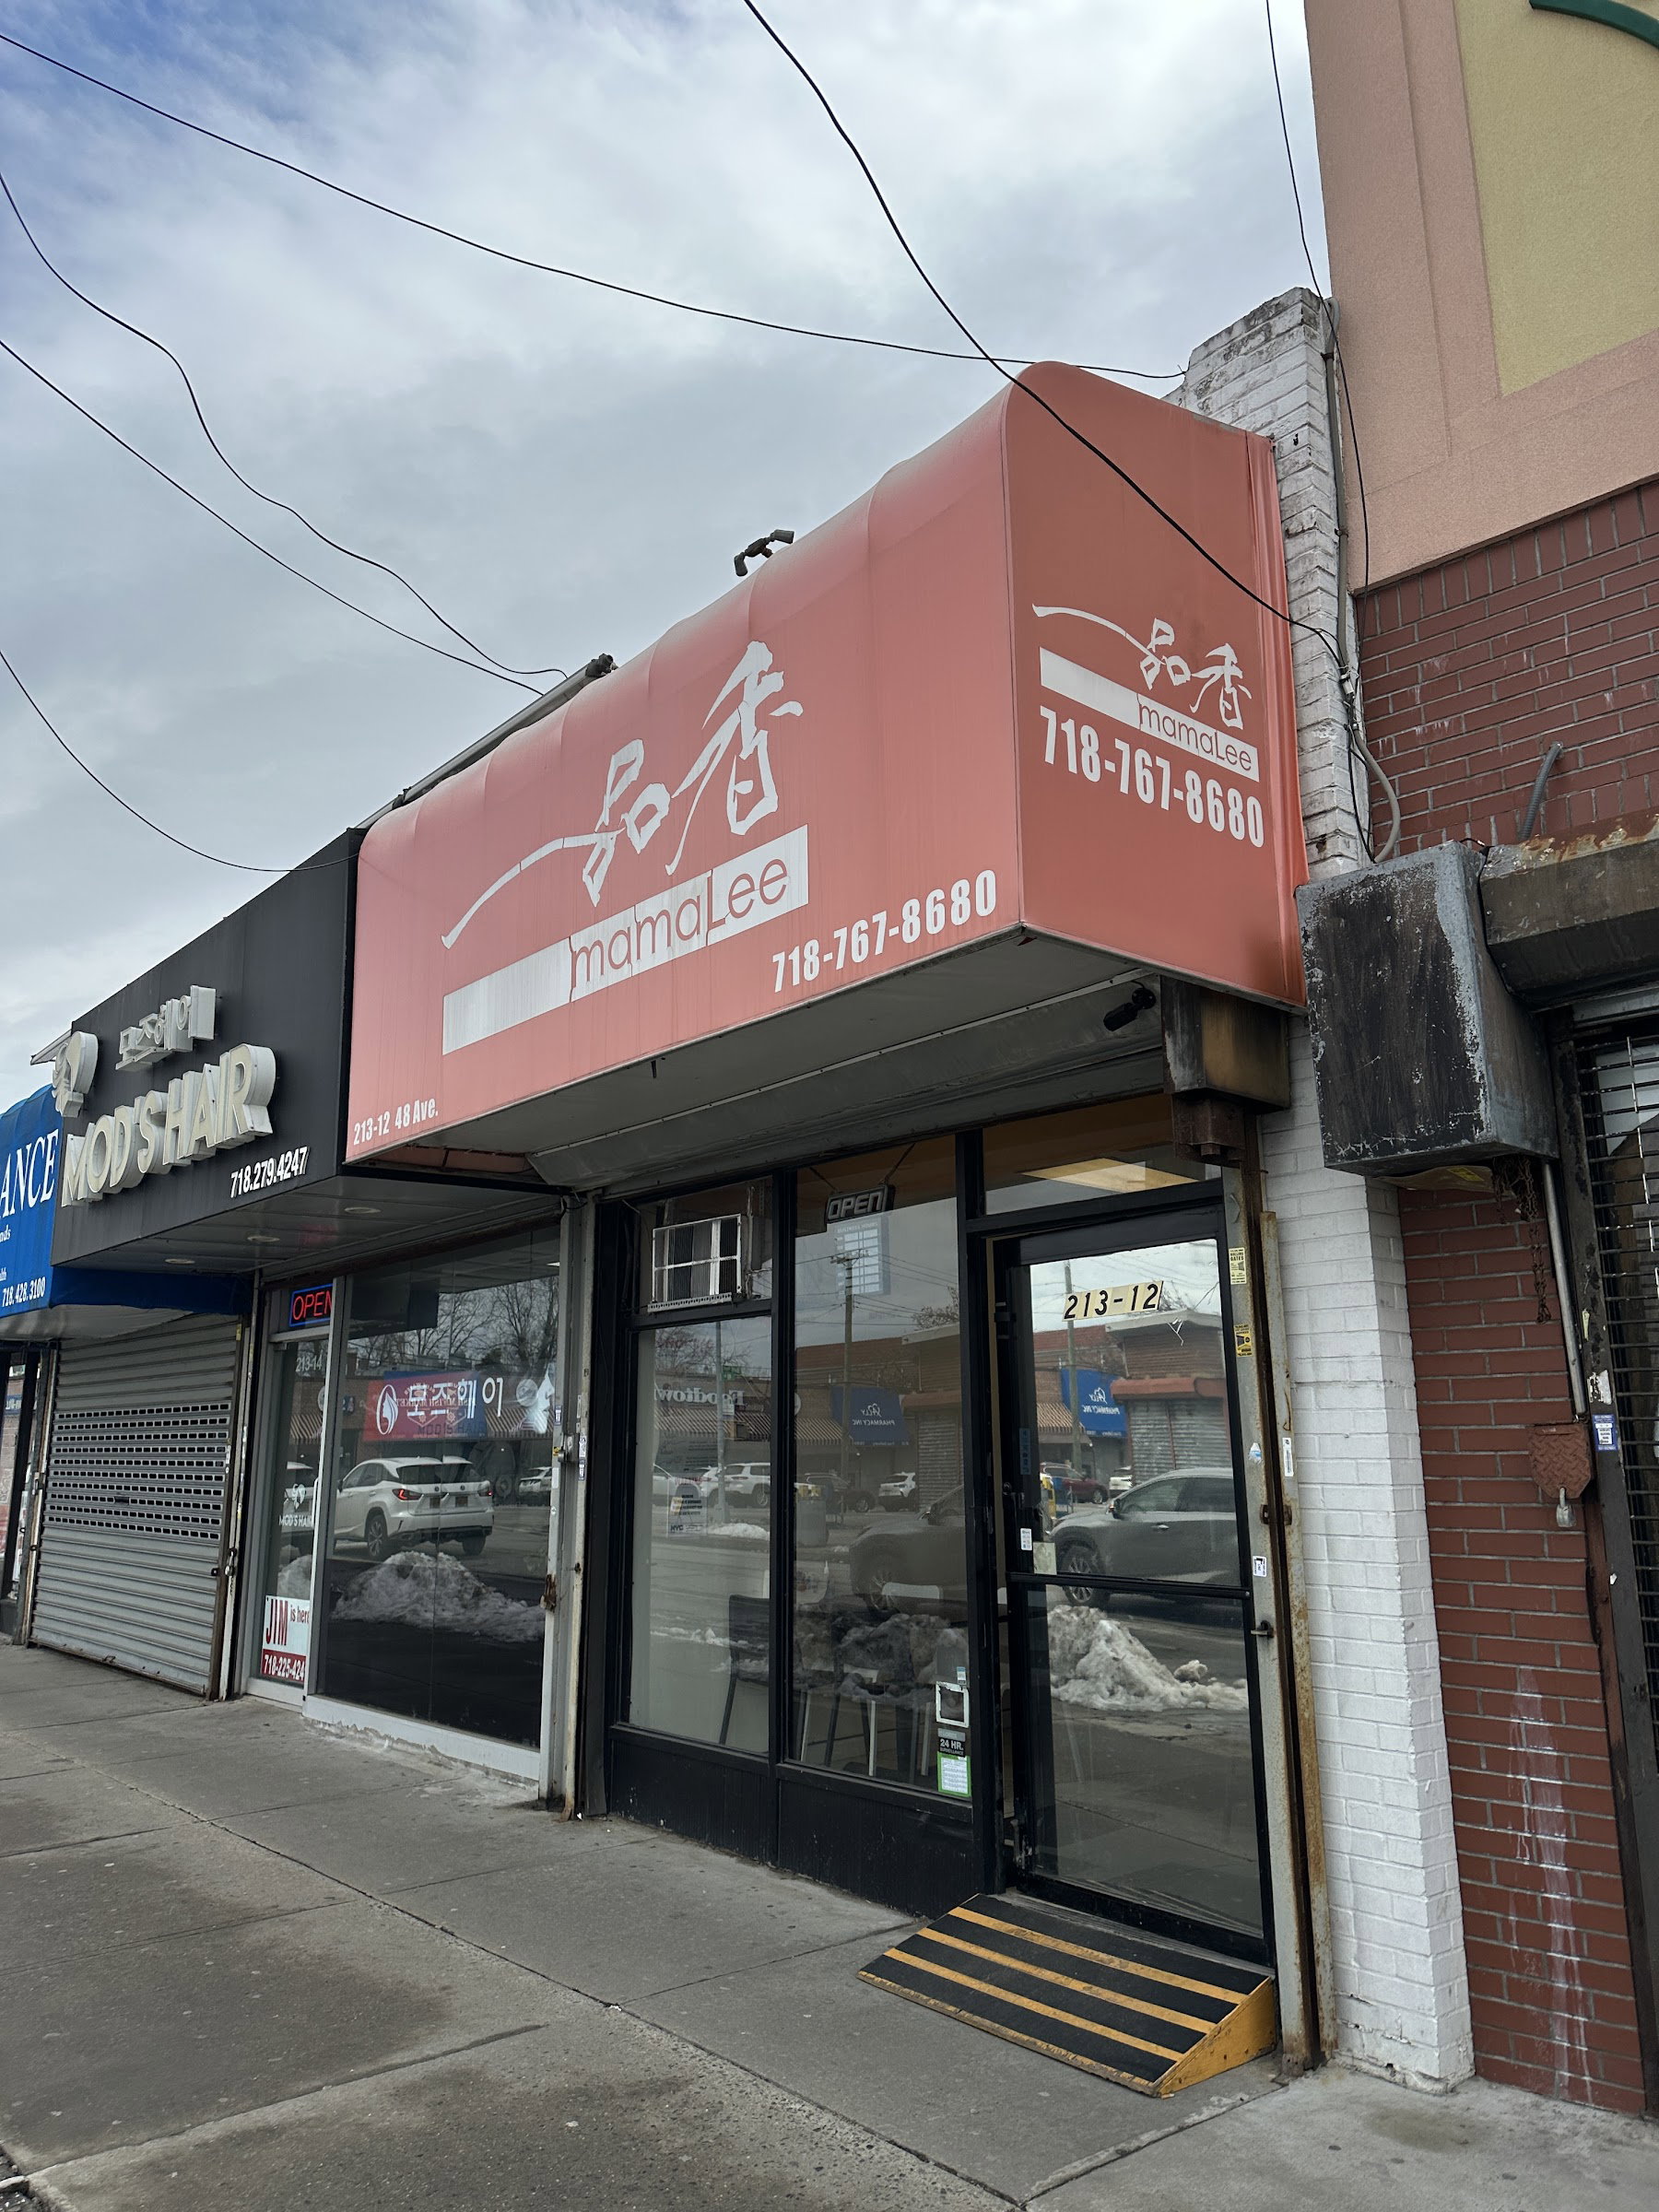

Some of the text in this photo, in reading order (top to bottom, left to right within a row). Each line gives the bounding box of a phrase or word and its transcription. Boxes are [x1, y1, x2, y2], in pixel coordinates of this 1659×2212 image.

[1140, 703, 1253, 771] mamaLee
[1040, 705, 1265, 848] 718-767-8680
[571, 856, 790, 988] mamaLee
[771, 868, 997, 993] 718-767-8680
[163, 1043, 276, 1165] HAIR
[353, 1098, 439, 1146] 213-12 48 Ave.
[230, 1146, 309, 1198] 718.279.4247
[828, 1191, 883, 1220] OPEN
[2, 1276, 46, 1308] 718.428.3100
[1064, 1283, 1160, 1320] 213-12
[295, 1354, 323, 1372] 213-14
[265, 1598, 288, 1647] JIM
[290, 1604, 296, 1622] is
[940, 1738, 964, 1750] 24 HR.
